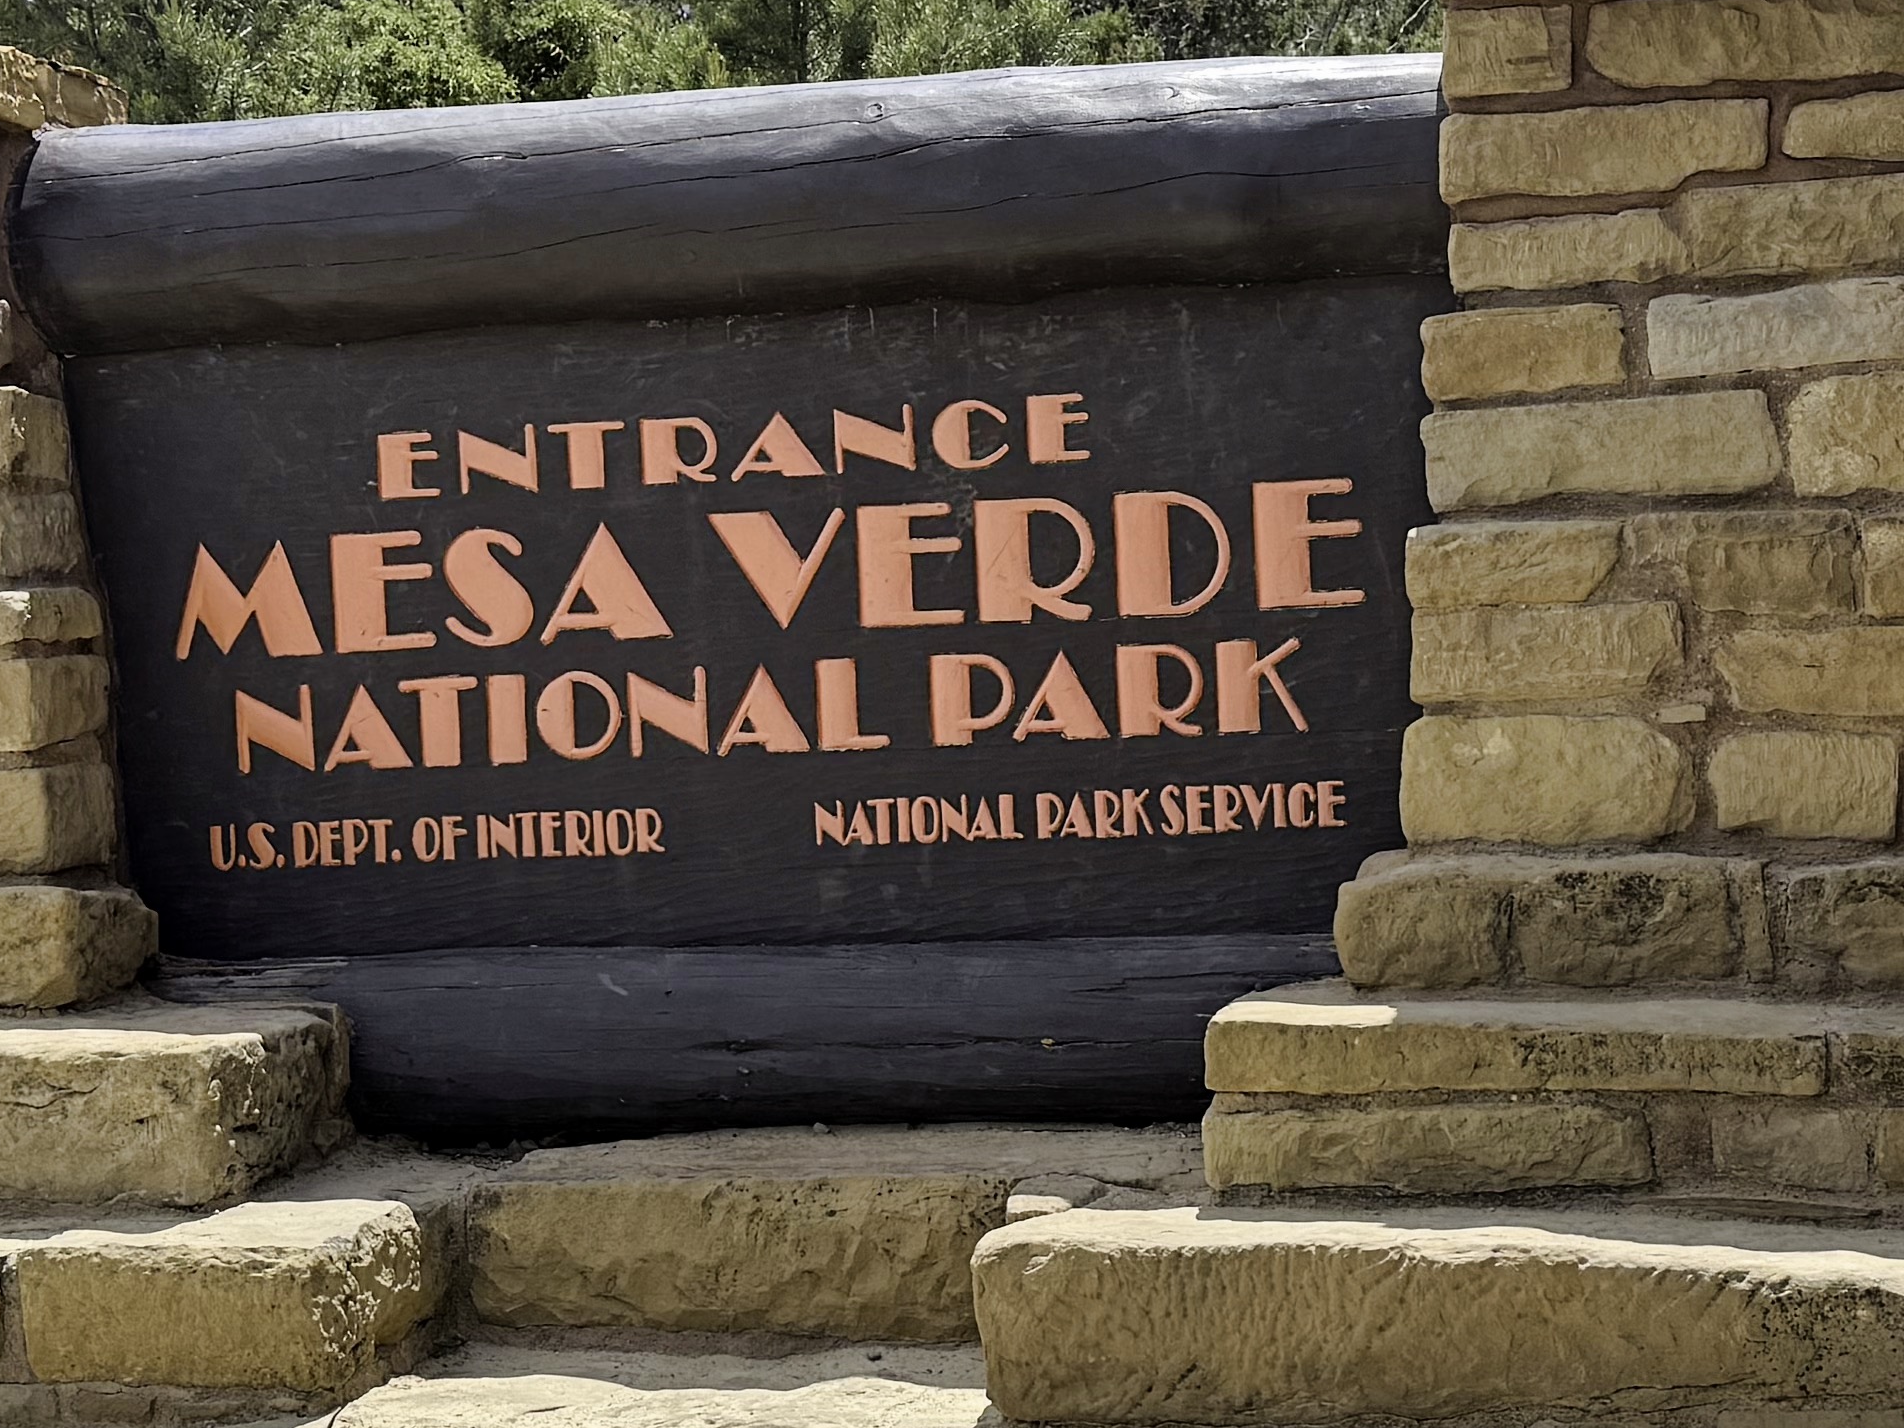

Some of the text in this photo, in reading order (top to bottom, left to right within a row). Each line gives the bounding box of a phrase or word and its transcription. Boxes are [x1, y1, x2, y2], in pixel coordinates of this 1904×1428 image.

[376, 394, 1090, 502] ENTRANCE
[176, 478, 1366, 661] MESA VERDE
[235, 638, 1308, 775] NATIONAL PARK
[209, 808, 666, 871] U.S. DEPT. OF INTERIOR
[814, 780, 1347, 846] NATIONAL PARK SERVICE
